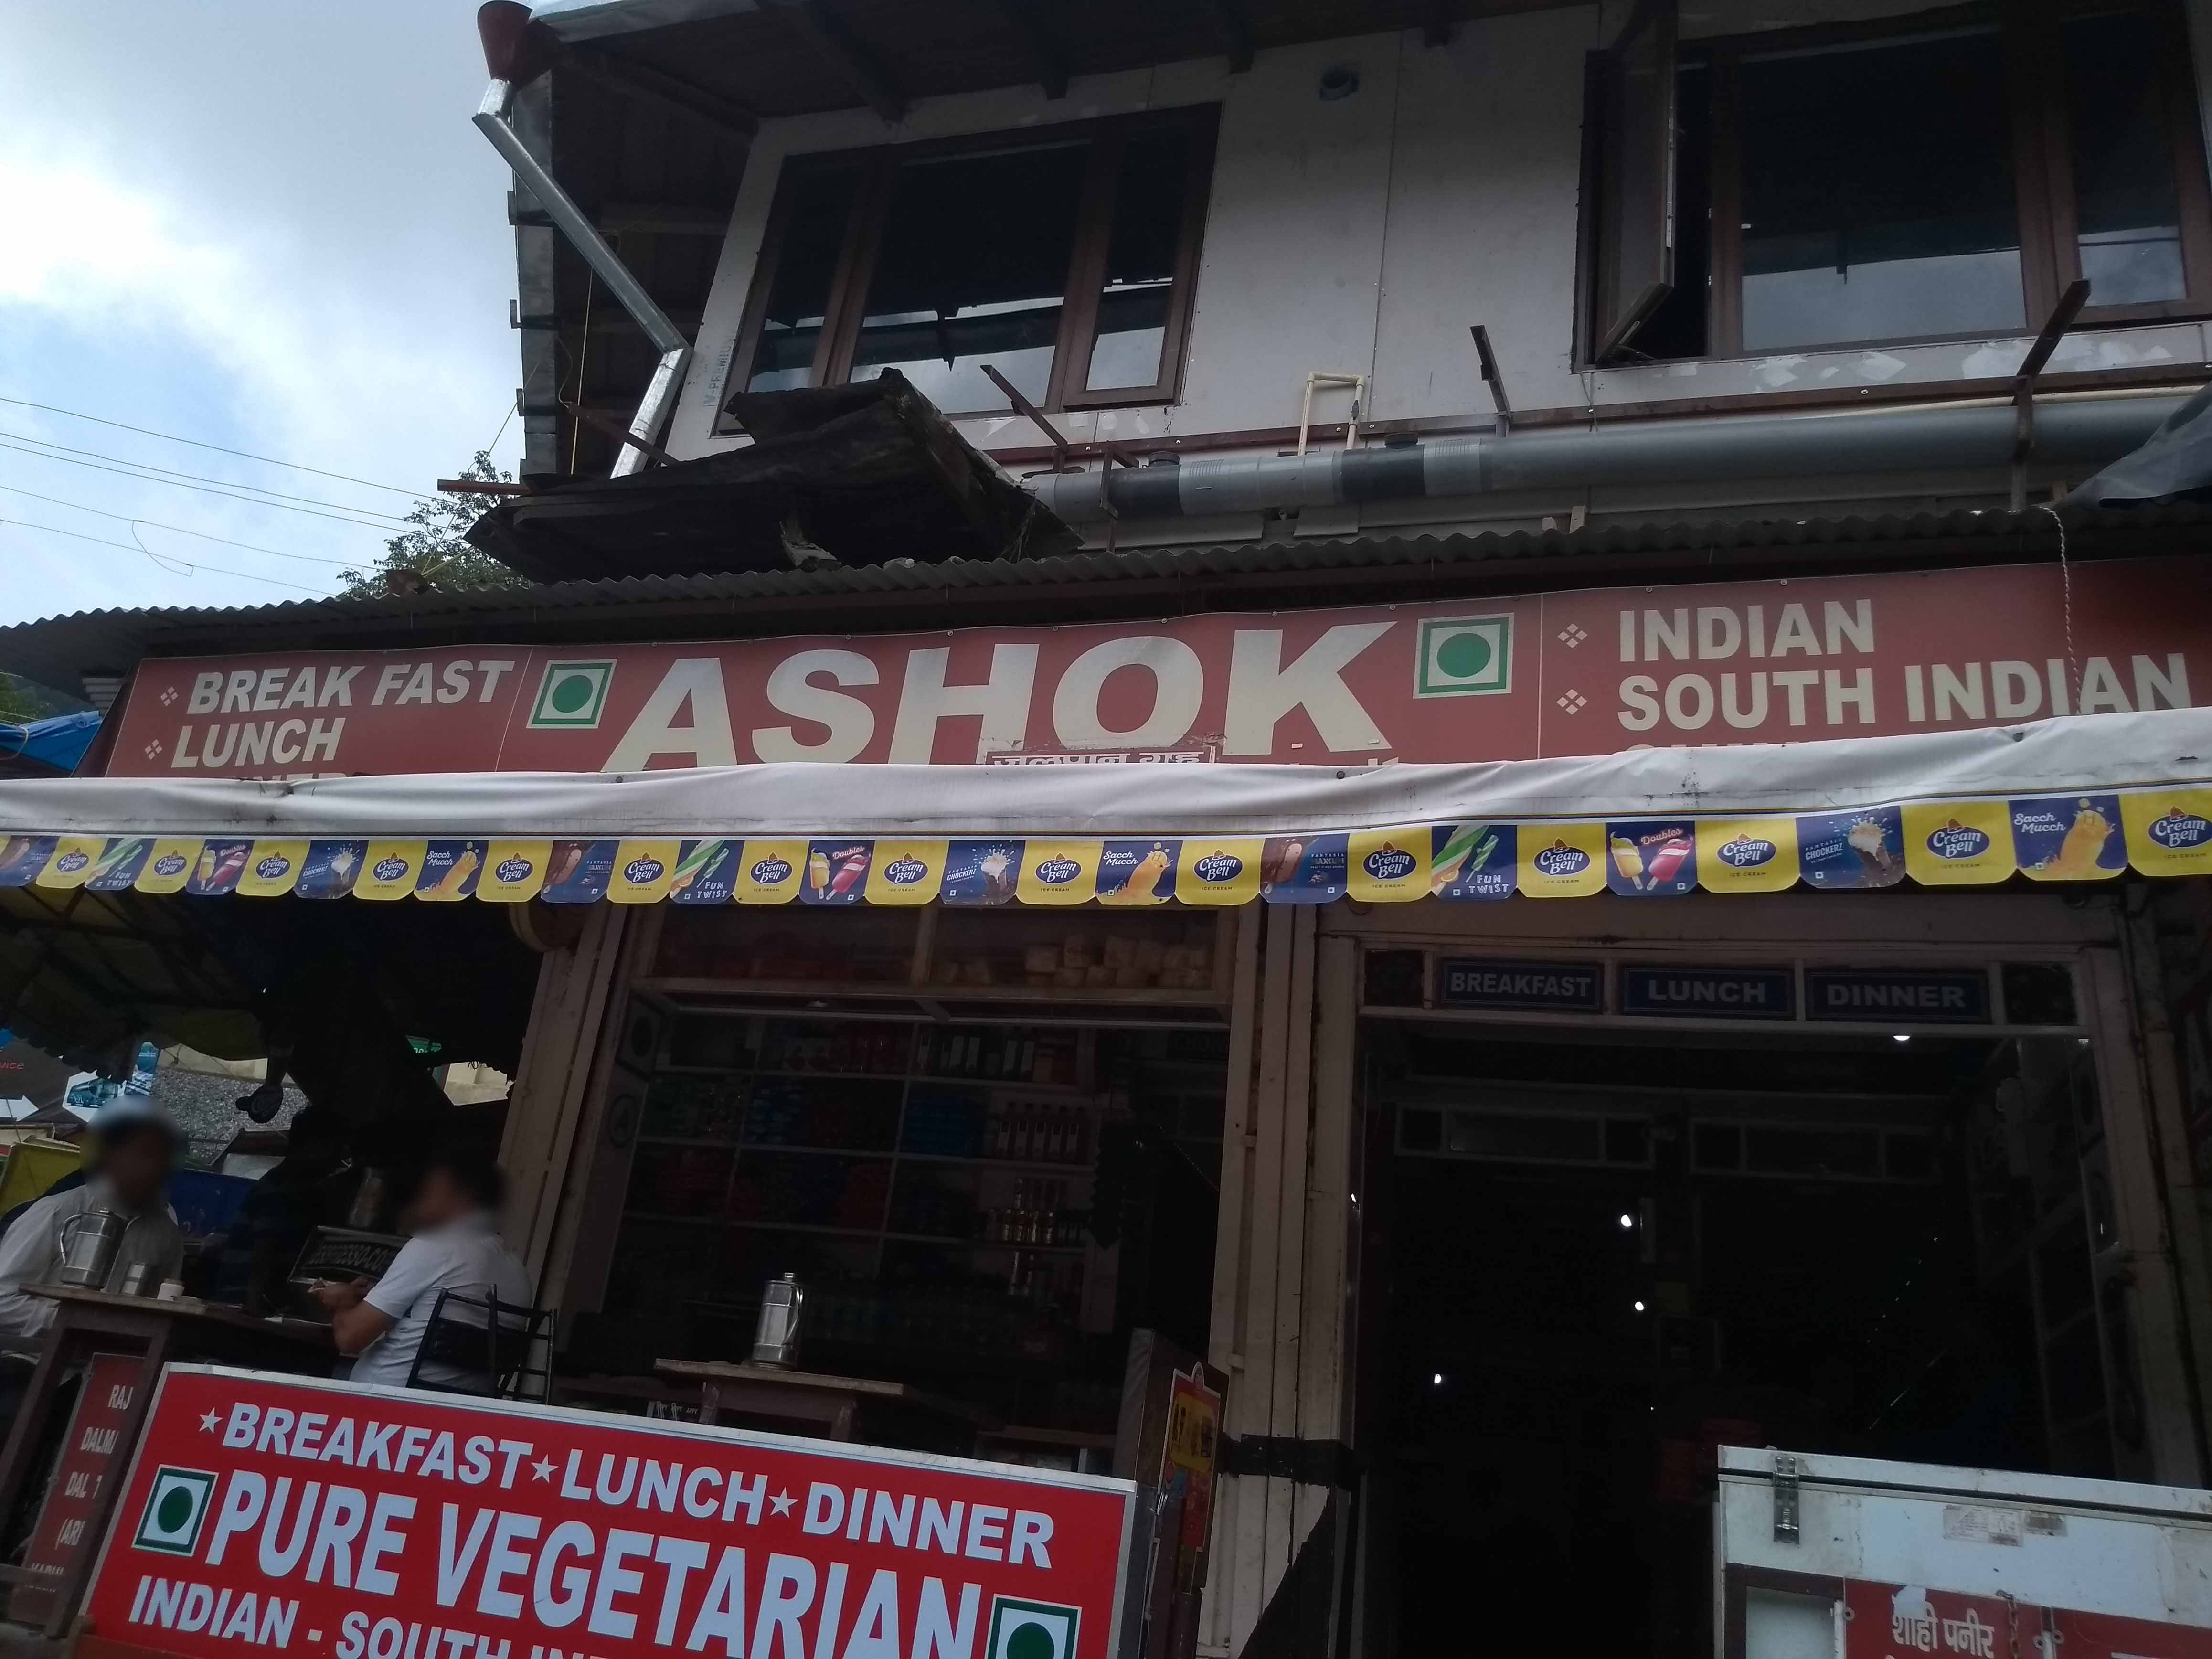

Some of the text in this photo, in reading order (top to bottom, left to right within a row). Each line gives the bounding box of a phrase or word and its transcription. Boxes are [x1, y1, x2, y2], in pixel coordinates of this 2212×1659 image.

[1619, 599, 1874, 662] INDIAN
[187, 660, 515, 714] BREAK FAST
[1618, 653, 2192, 731] SOUTH INDIAN
[599, 621, 1397, 773] ASHOK
[171, 718, 345, 768] LUNCH
[2014, 812, 2057, 825] Sacch
[2021, 822, 2066, 833] Mucch
[2155, 820, 2206, 836] Cream
[1641, 828, 1682, 845] Doubles
[1933, 831, 1981, 847] Cream
[2169, 830, 2197, 847] Bell
[220, 845, 246, 856] Doubles
[427, 851, 451, 859] Sacch
[833, 846, 864, 859] Doubles
[1103, 851, 1134, 859] Sacch
[1723, 842, 1768, 856] Cream
[1806, 842, 1843, 860] CHOCKERZ
[1945, 841, 1972, 857] Bell
[61, 856, 87, 864] Cream
[158, 858, 184, 867] Cream
[1369, 854, 1410, 868] Cream
[1540, 851, 1583, 865] Cream
[1734, 851, 1760, 865] Bell
[61, 862, 79, 871] Bell
[159, 865, 178, 875] Bell
[260, 860, 288, 870] Cream
[377, 861, 405, 872] Cream
[500, 862, 529, 873] Cream
[628, 862, 660, 874] Cream
[755, 862, 787, 874] Cream
[889, 862, 924, 874] Cream
[1041, 862, 1076, 874] Cream
[1199, 859, 1237, 871] Cream
[1378, 863, 1402, 878] Bell
[1550, 861, 1575, 874] Bell
[262, 867, 281, 878] Bell
[380, 869, 399, 880] Bell
[503, 870, 522, 881] Bell
[633, 870, 653, 883] Bell
[760, 871, 781, 883] Bell
[894, 871, 916, 883] Bell
[947, 868, 977, 881] CHOCKERZ
[1046, 870, 1069, 883] Bell
[1207, 867, 1229, 880] Bell
[1477, 874, 1501, 883] FUN
[697, 890, 727, 898] TWIST
[1468, 884, 1509, 894] TWIST
[1449, 972, 1591, 997] BREAKFAST
[1648, 978, 1766, 1004] LUNCH
[1826, 983, 1967, 1009] DINNER
[222, 1402, 1054, 1569] BREAKFAST LUNCH DINNER
[205, 1469, 982, 1659] PURE VEGETARIAN
[128, 1575, 299, 1648] INDIAN
[1942, 1608, 1995, 1659] पनीर
